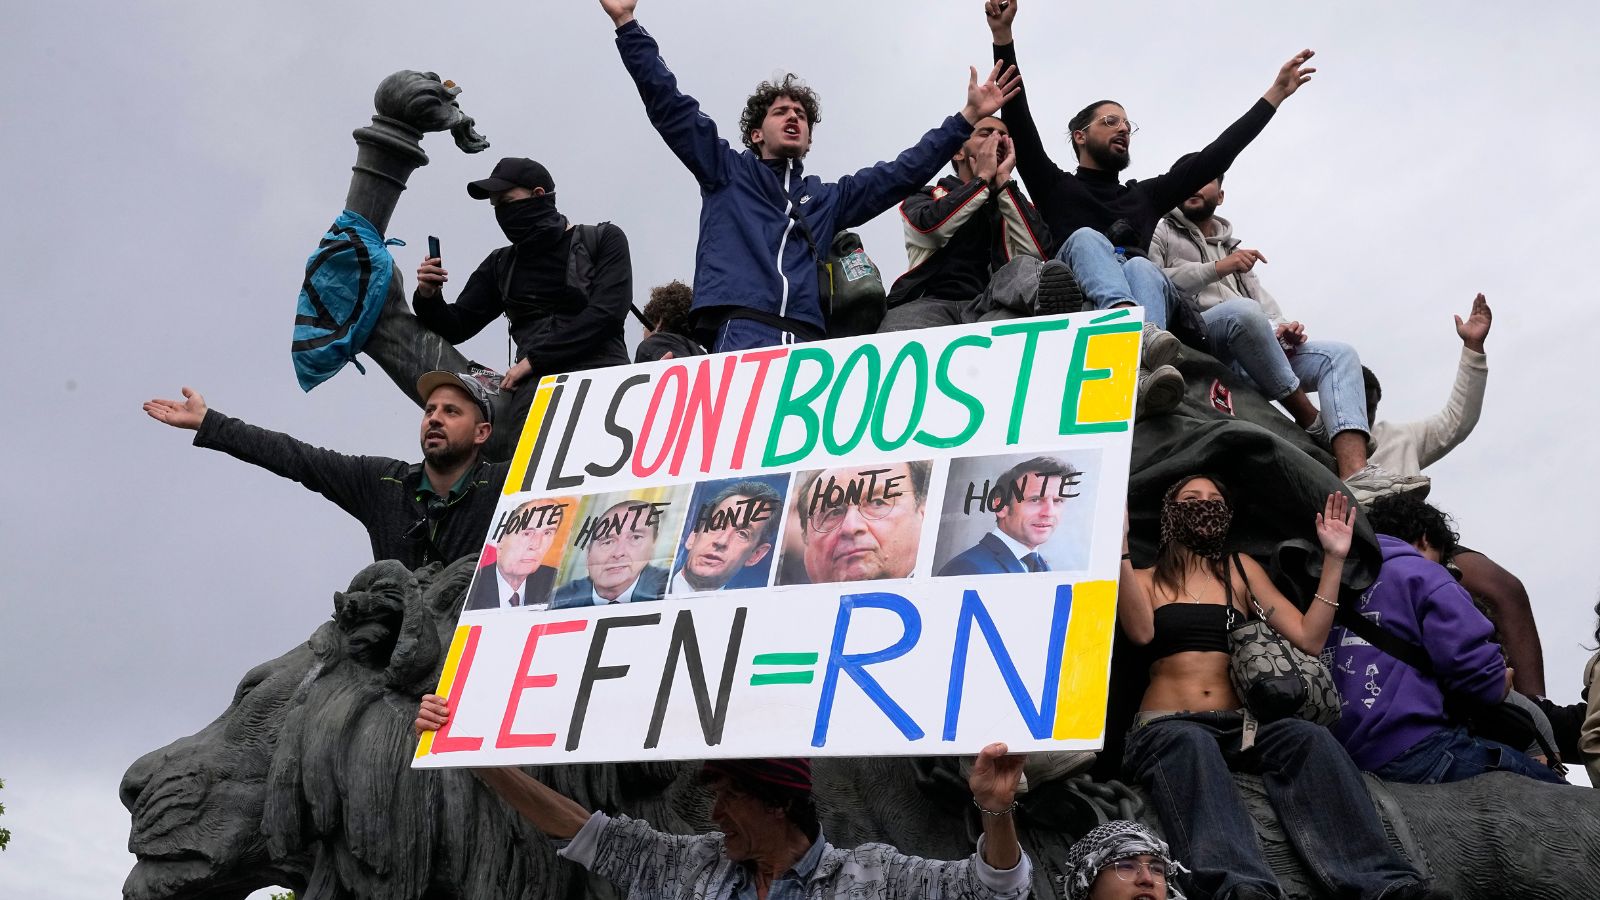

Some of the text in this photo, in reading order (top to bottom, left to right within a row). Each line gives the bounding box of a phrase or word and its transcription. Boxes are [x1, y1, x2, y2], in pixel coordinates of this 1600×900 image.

[632, 348, 789, 478] ONT
[761, 309, 1143, 467] BOOSTÉ
[694, 497, 777, 534] HONTE
[808, 468, 907, 516] HONTE
[963, 471, 1086, 516] HONTE
[492, 503, 570, 543] HONTE
[574, 502, 672, 550] HONTE
[811, 583, 1073, 747] RN
